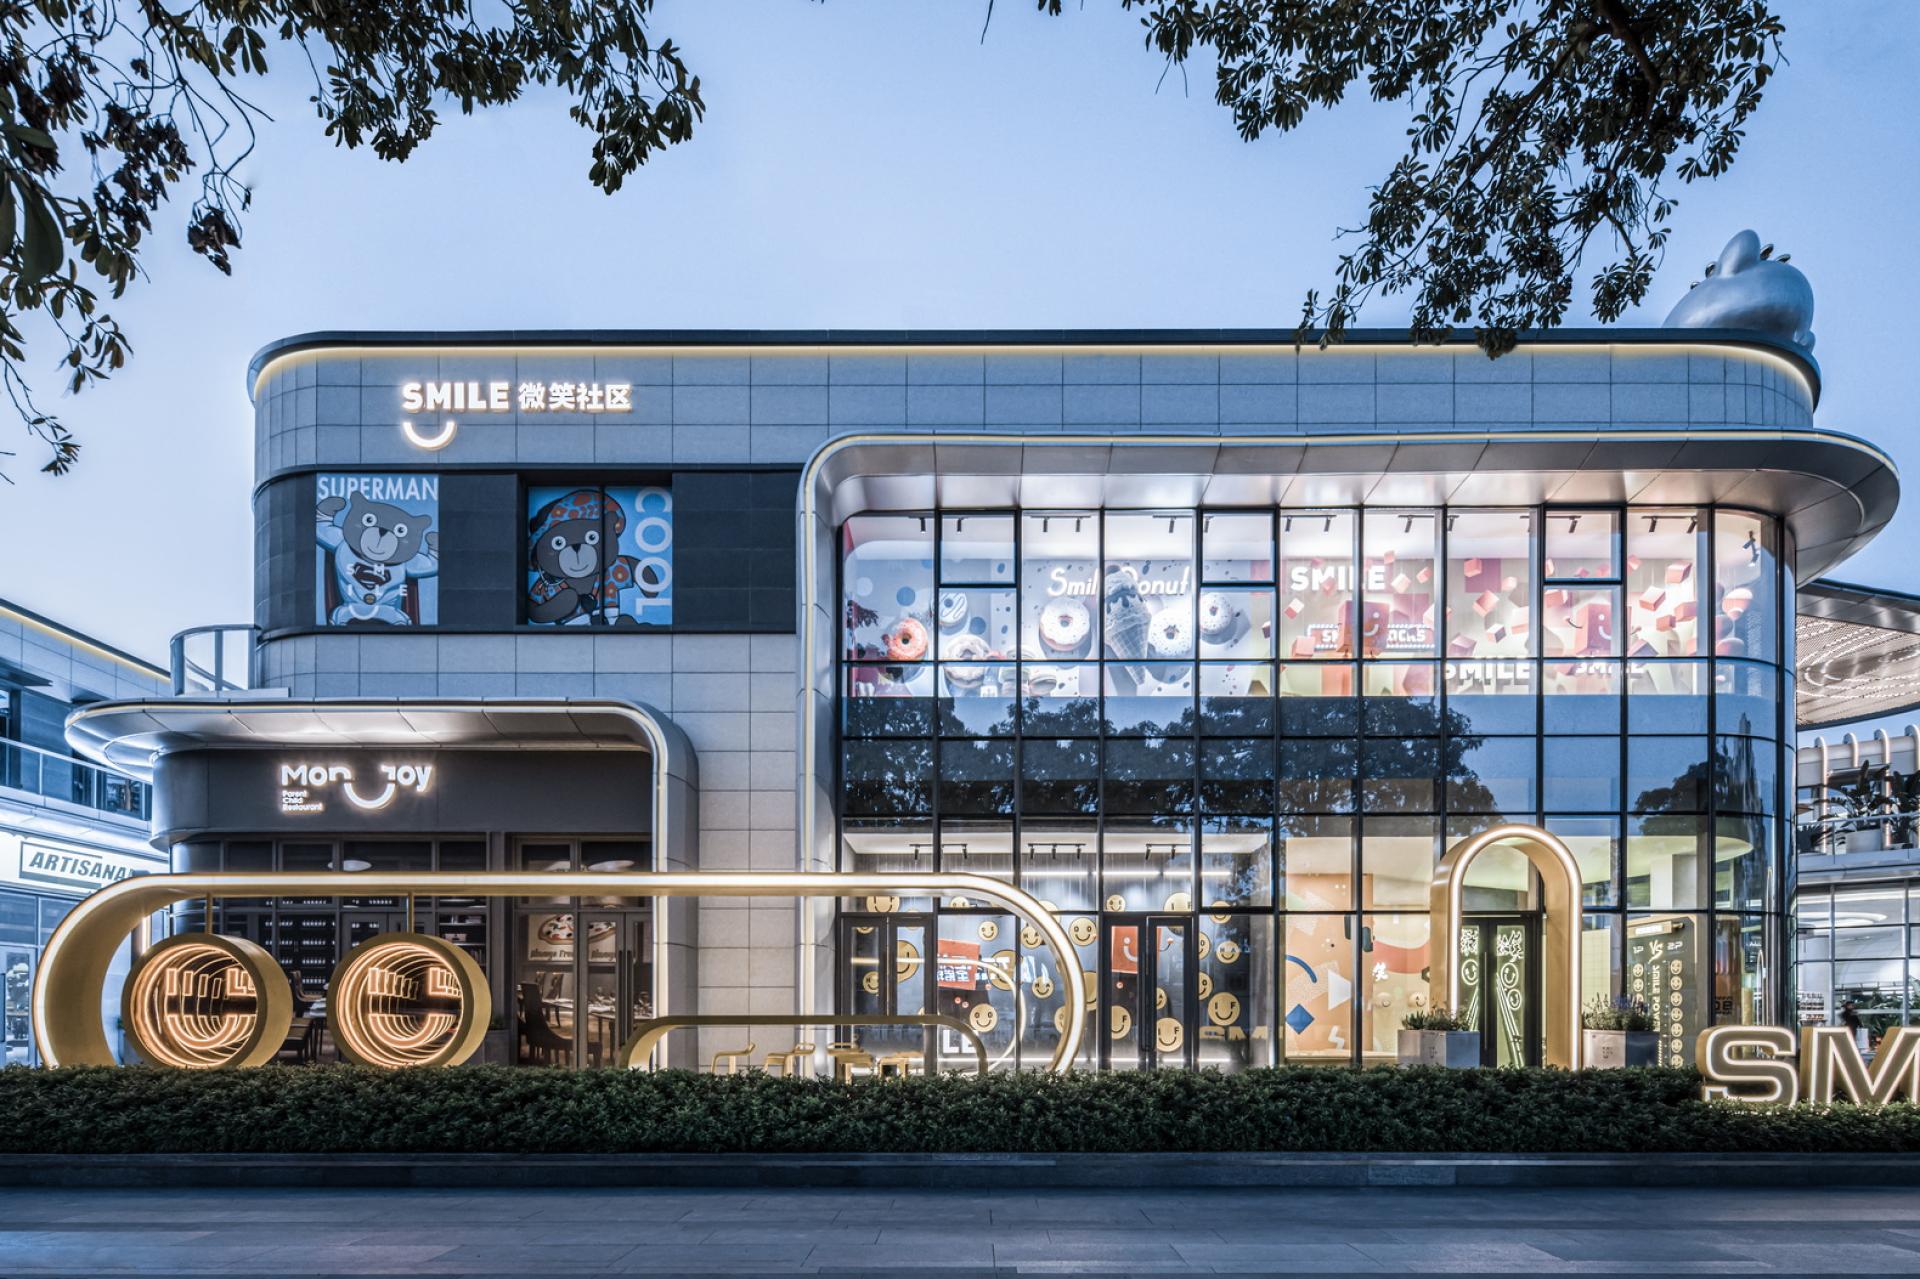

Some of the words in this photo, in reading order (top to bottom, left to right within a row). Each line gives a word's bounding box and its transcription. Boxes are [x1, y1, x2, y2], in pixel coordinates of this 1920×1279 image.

[402, 381, 510, 413] SMILE
[517, 382, 632, 412] 微笑社区
[318, 476, 438, 501] SUPERMAN
[634, 487, 673, 616] COOL
[1047, 566, 1099, 596] Smil
[281, 764, 352, 786] Mon
